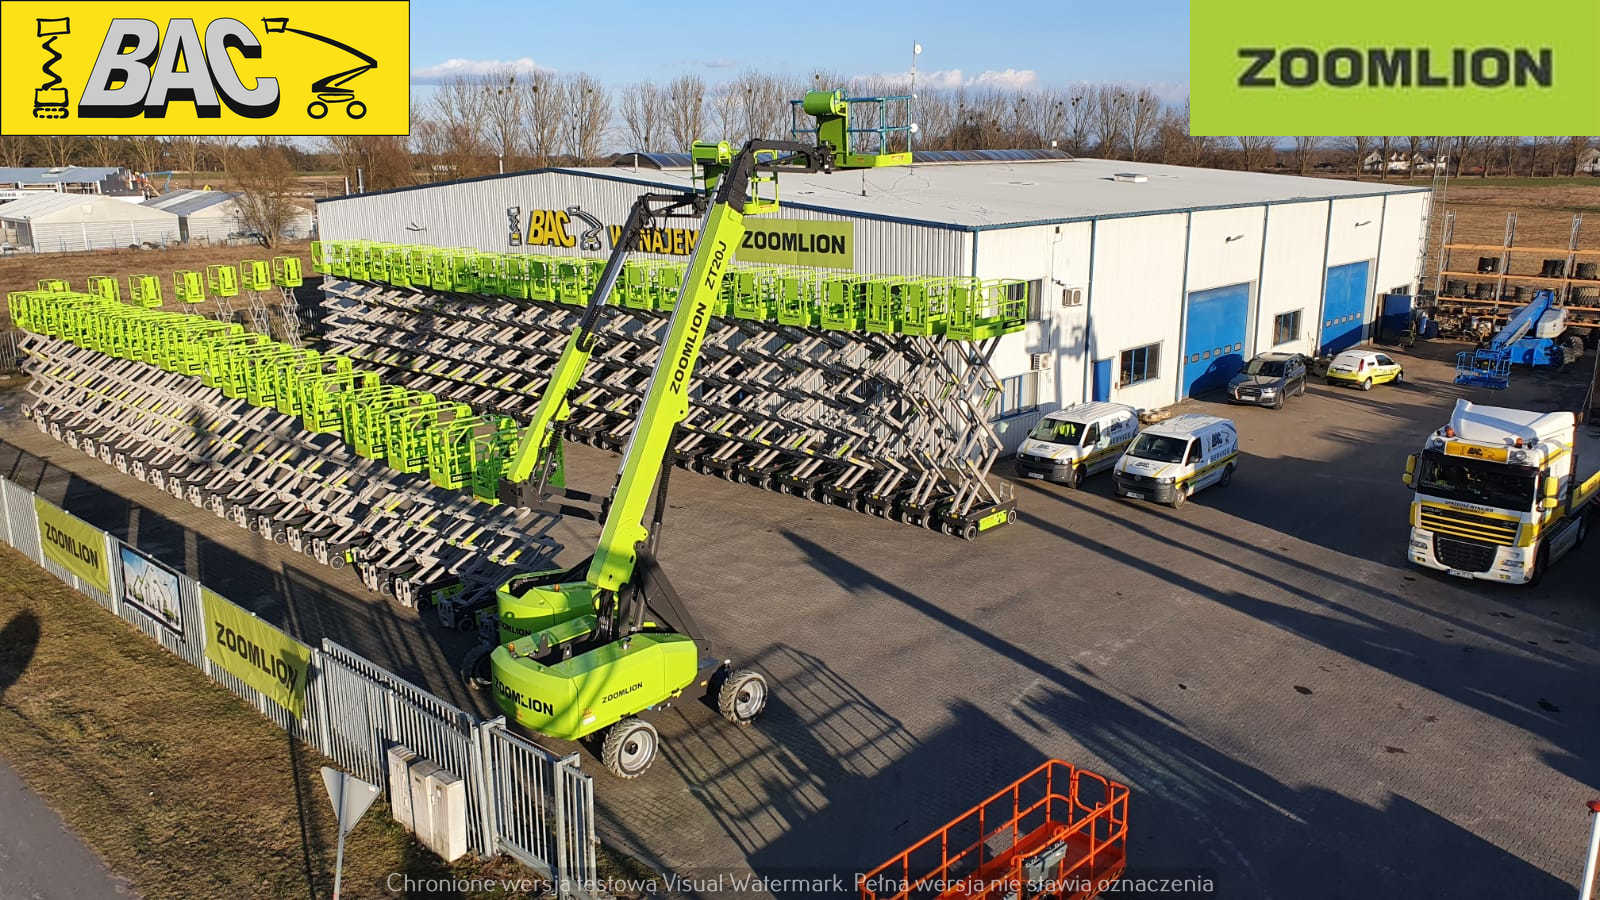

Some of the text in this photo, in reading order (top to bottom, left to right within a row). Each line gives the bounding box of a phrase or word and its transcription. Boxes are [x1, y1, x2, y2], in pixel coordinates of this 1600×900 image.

[527, 208, 700, 256] BAC WNAJEM
[741, 230, 846, 255] ZOOMLION
[670, 240, 727, 395] ZOOMLION ZT20J
[44, 521, 99, 569] ZOOMLION
[215, 622, 299, 693] ZOOMLION
[495, 677, 554, 717] ZOOMLION
[601, 681, 643, 704] ZOOMLION
